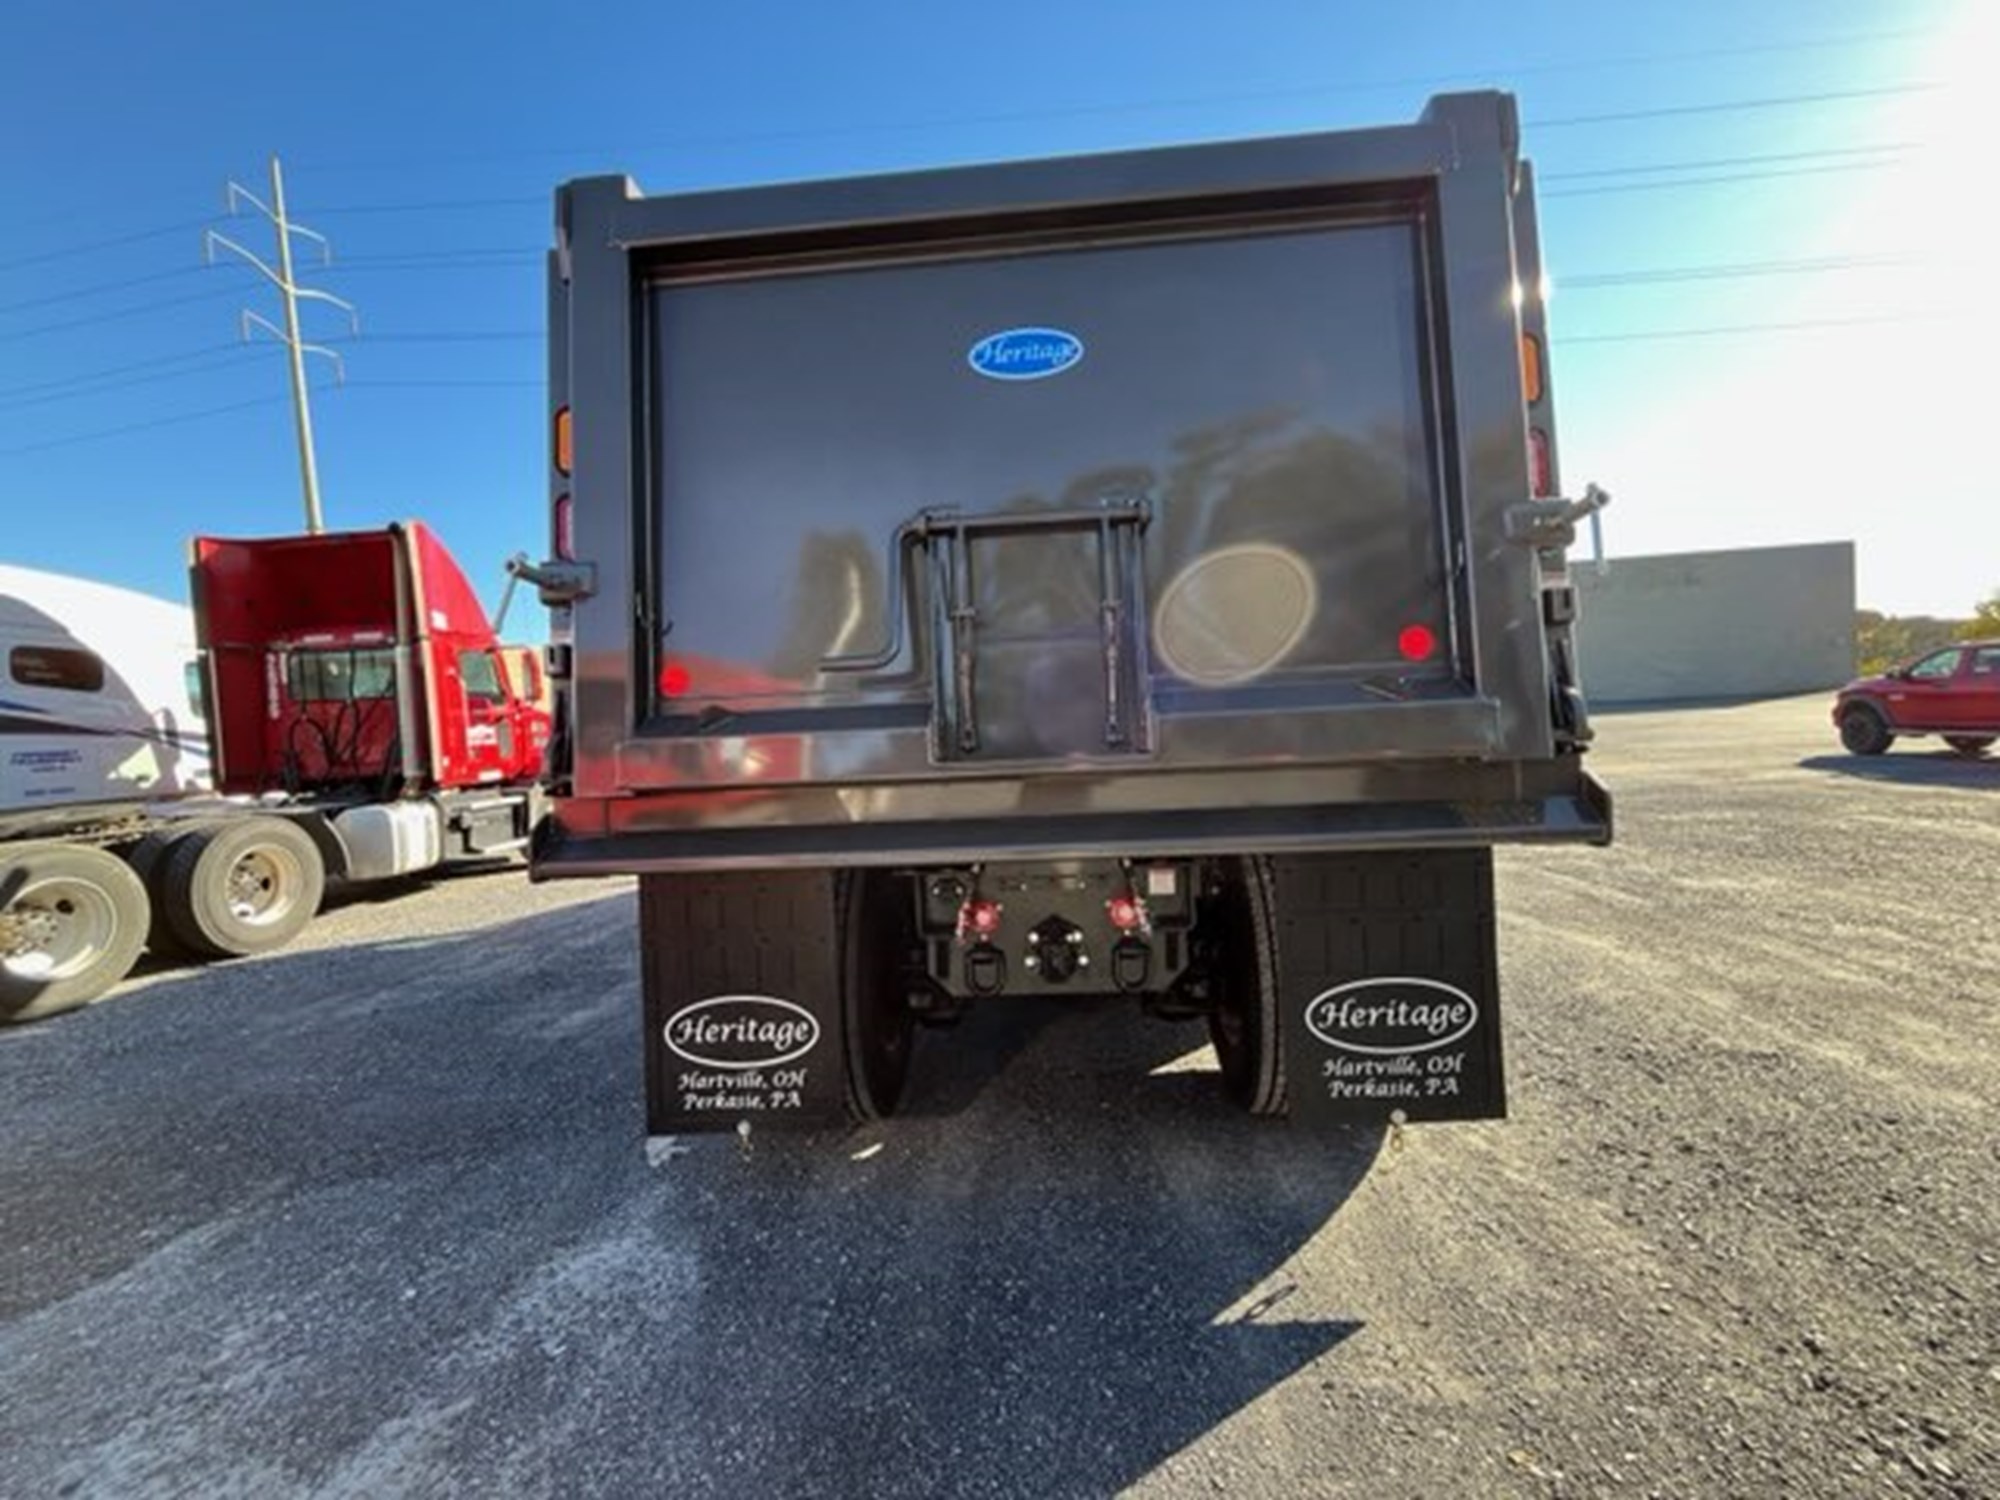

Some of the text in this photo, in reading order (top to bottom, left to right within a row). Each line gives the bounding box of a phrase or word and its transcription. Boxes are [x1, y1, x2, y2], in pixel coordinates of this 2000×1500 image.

[976, 337, 1077, 366] Heritage
[1317, 997, 1467, 1036] Heritage
[675, 1014, 810, 1051] Heritage
[1322, 1053, 1466, 1077] Hartville, OH
[677, 1068, 808, 1091] Hartville, OH
[1328, 1077, 1460, 1099] Perkasie, PA
[683, 1090, 802, 1111] Perkasie, PA
